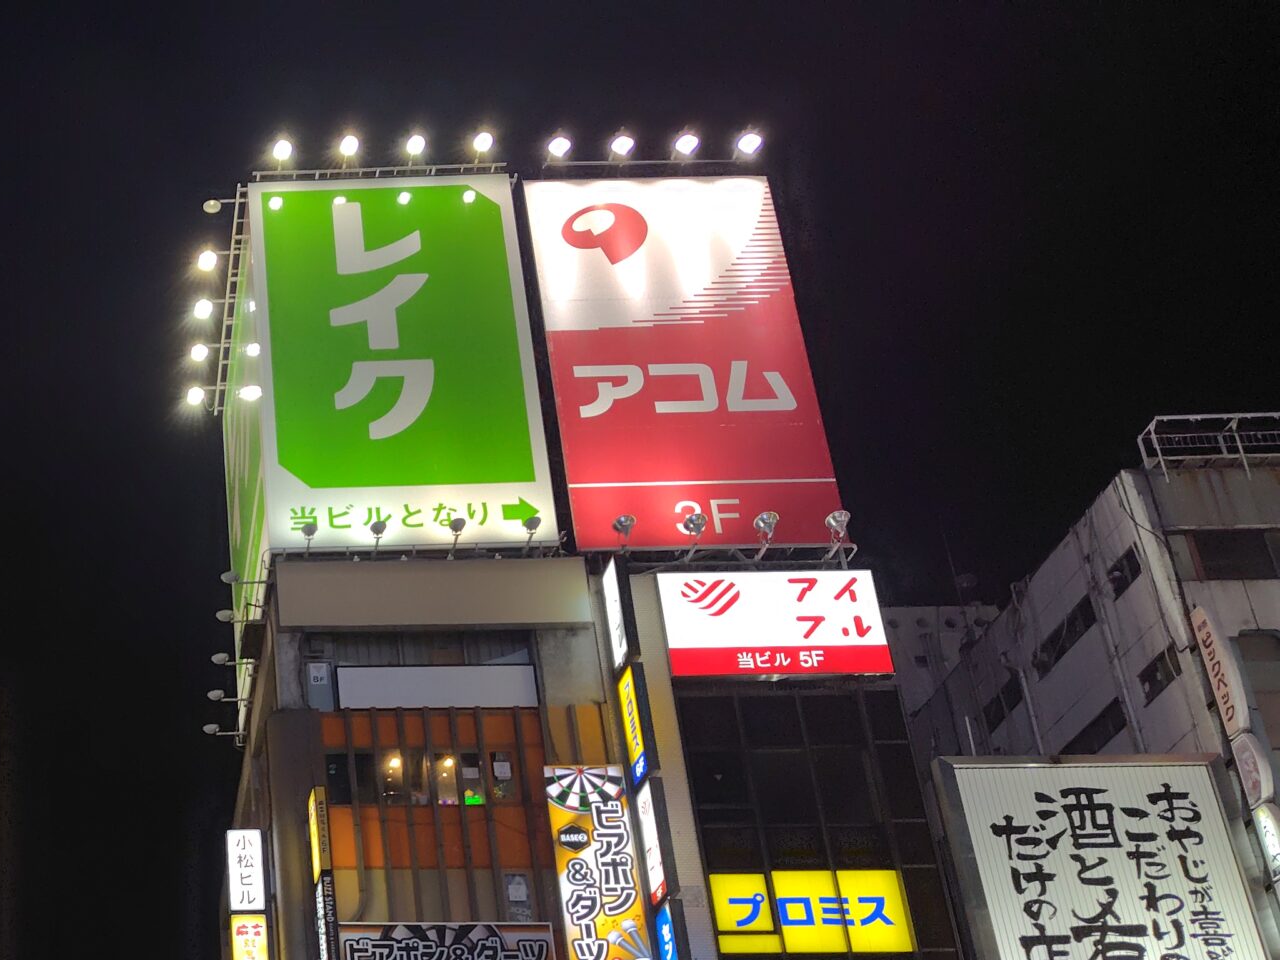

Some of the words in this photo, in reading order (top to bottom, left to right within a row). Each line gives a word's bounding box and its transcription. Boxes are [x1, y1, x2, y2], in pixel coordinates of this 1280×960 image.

[329, 202, 434, 440] レイク
[572, 361, 799, 419] アコム
[288, 502, 491, 531] 当ビルとなり
[674, 498, 740, 535] 3F
[788, 577, 859, 603] アイ
[796, 614, 873, 640] フル
[737, 651, 791, 669] 当ビル
[799, 650, 825, 668] 5F
[623, 680, 642, 752] プロミス
[234, 835, 257, 905] 小松ビル
[592, 801, 636, 916] ビアポン
[326, 896, 334, 922] STAND
[728, 893, 896, 928] プロミス
